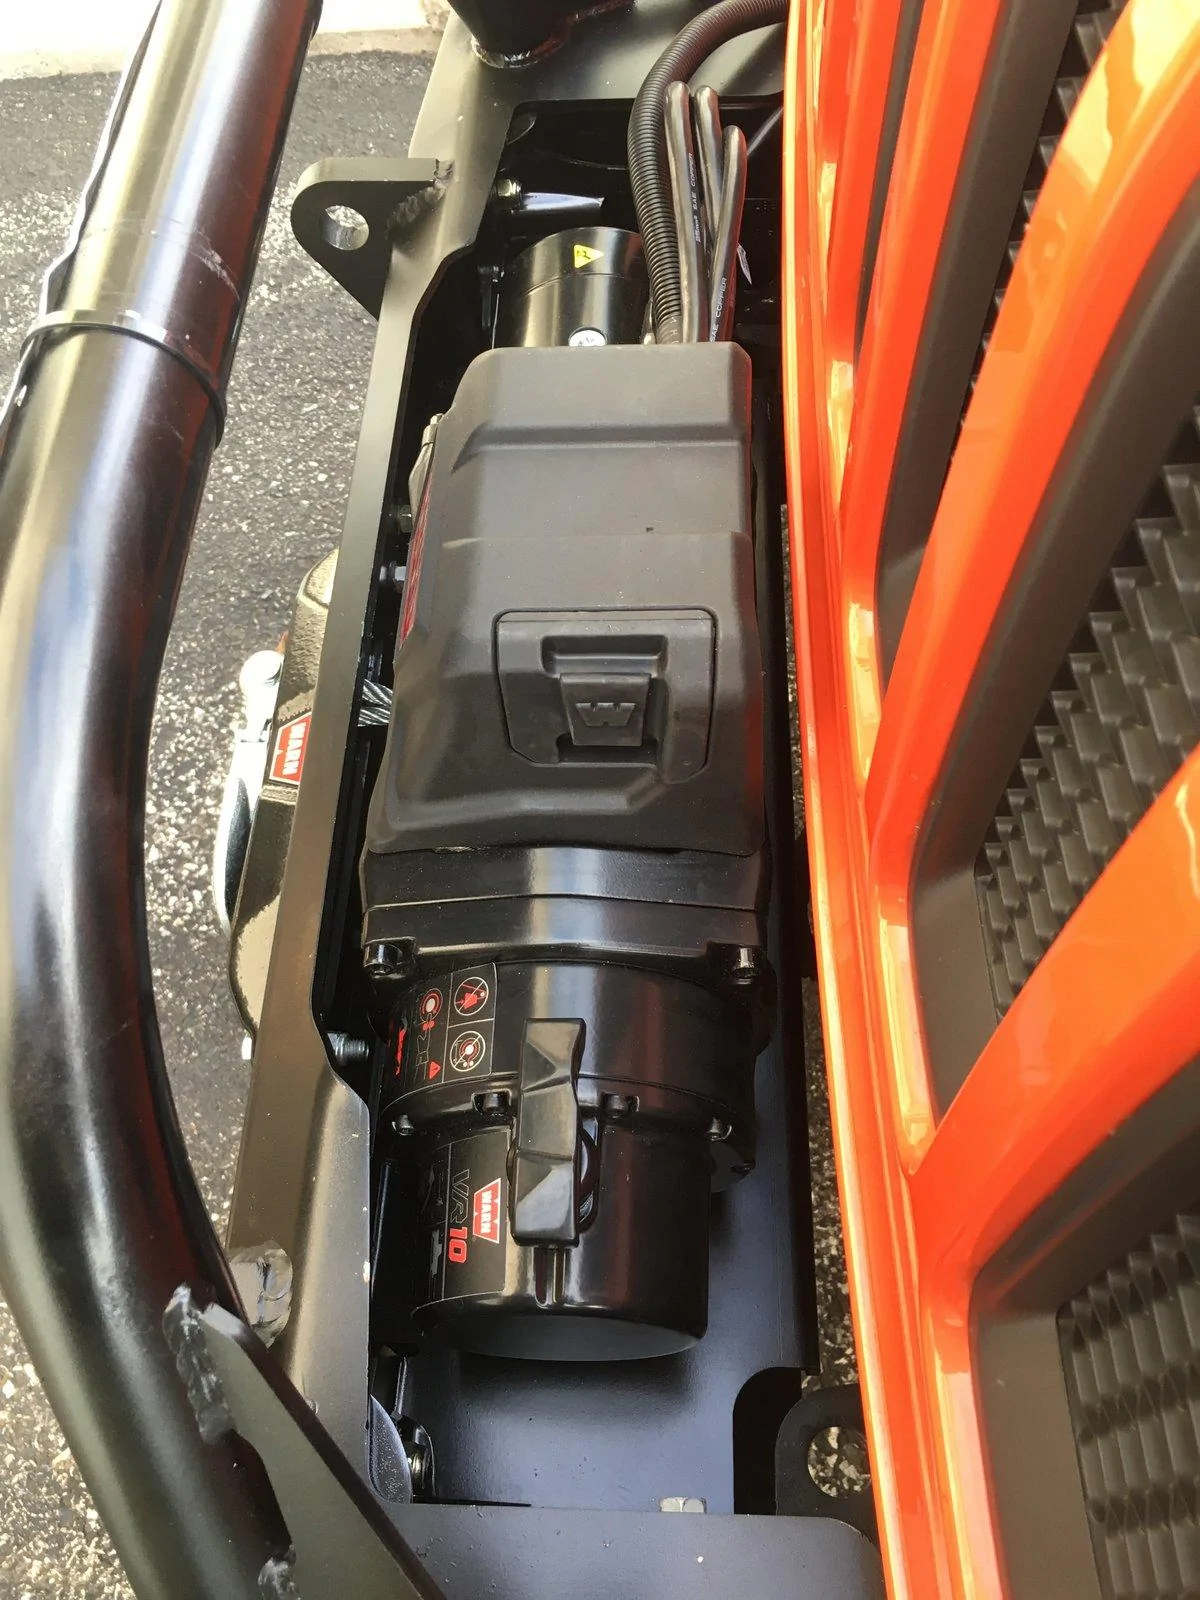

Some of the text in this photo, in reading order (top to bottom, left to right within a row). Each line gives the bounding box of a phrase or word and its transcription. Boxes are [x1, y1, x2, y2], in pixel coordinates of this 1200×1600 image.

[688, 152, 696, 187] COPPER
[709, 277, 727, 343] SAE COPPER
[282, 722, 307, 776] WARN
[480, 1190, 492, 1234] WARN
